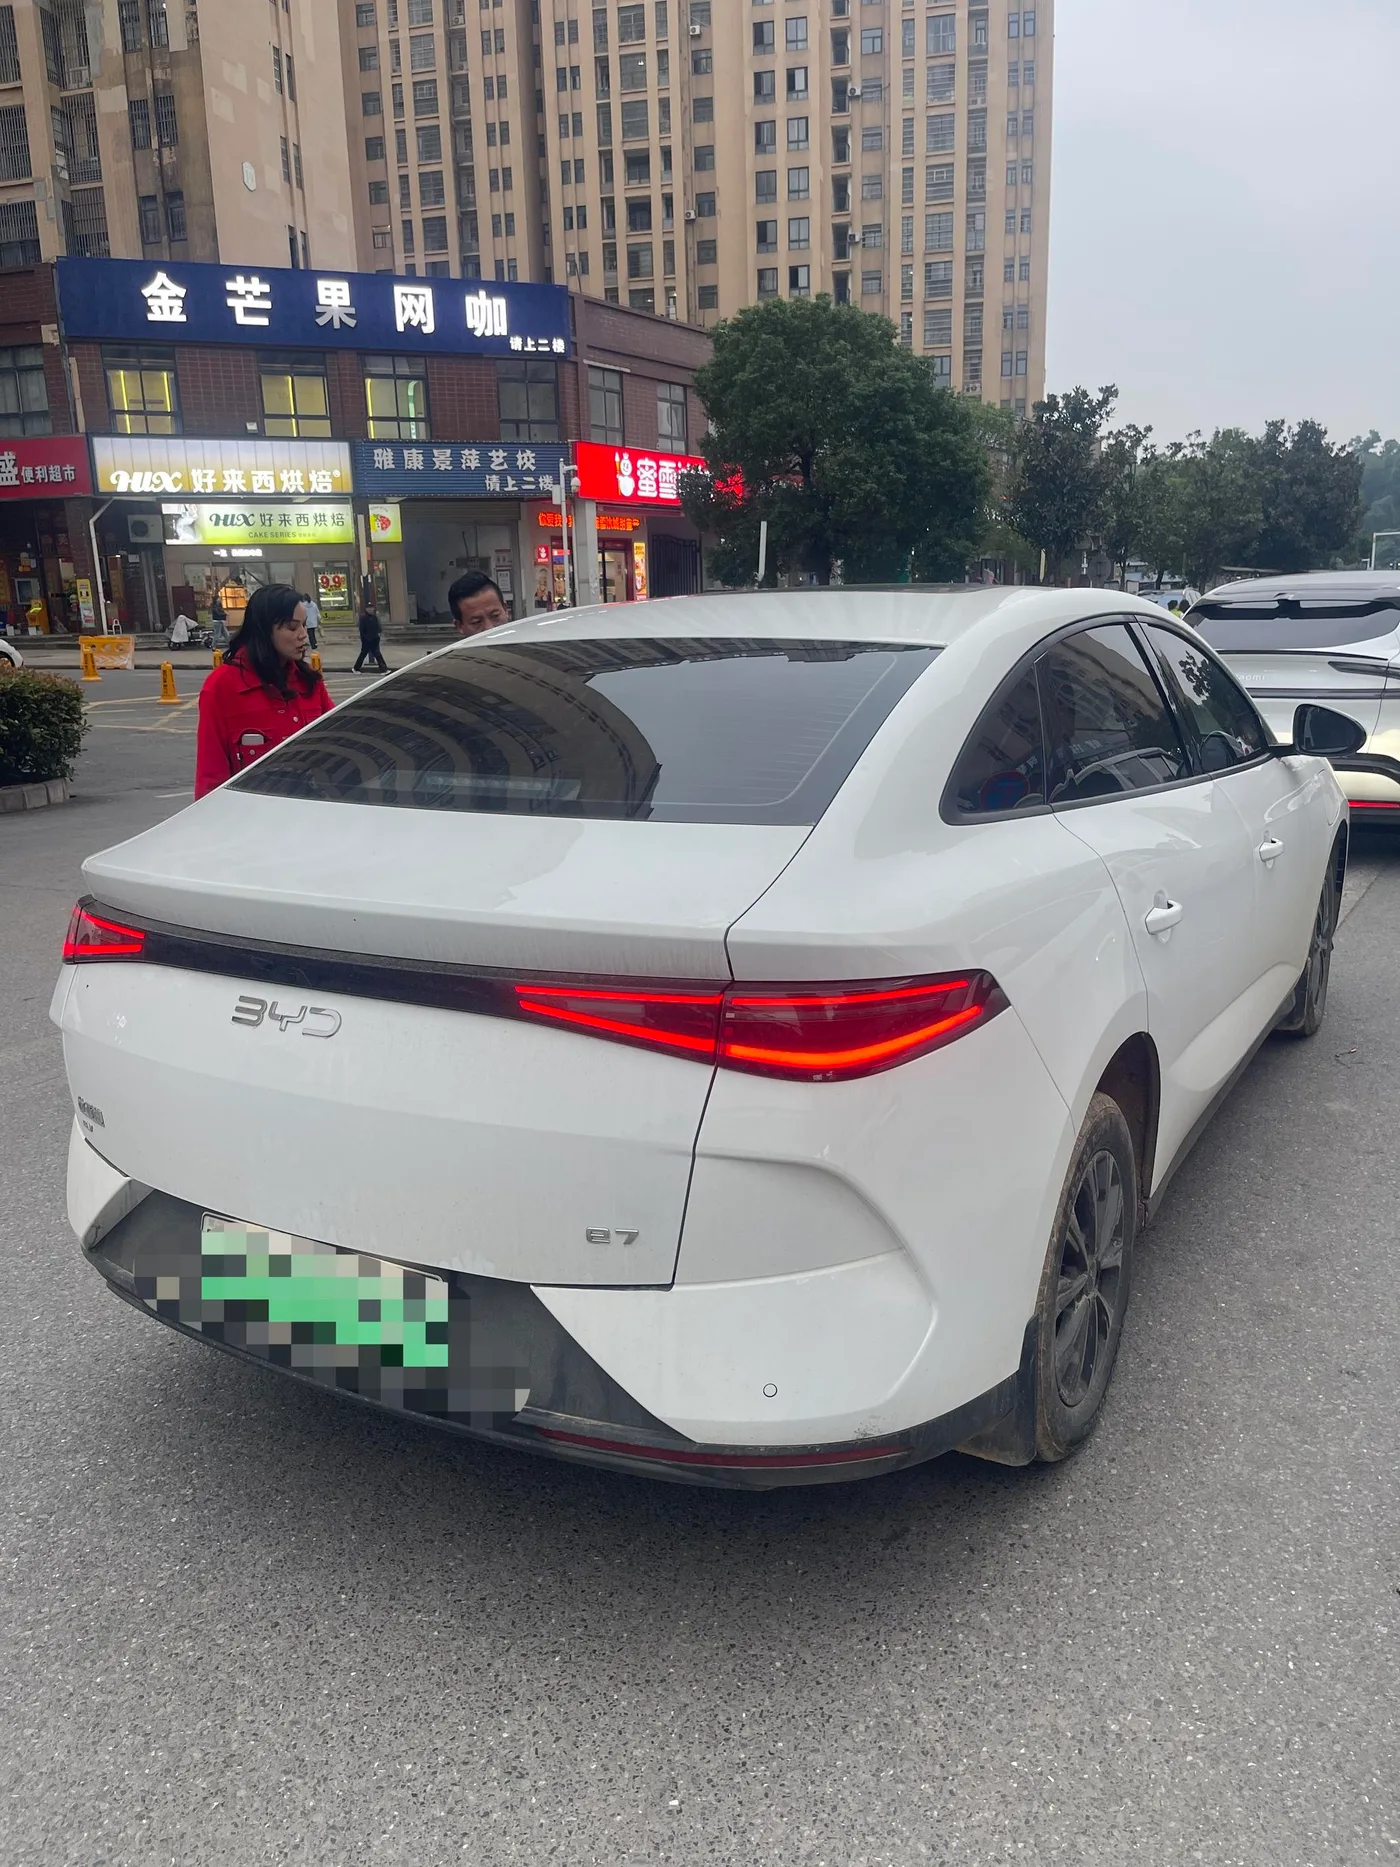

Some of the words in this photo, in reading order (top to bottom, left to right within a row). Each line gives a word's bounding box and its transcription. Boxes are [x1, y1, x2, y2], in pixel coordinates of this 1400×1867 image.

[141, 271, 508, 338] 金芒果网咖
[509, 335, 565, 354] 请上二楼
[22, 464, 76, 483] 便利超市
[191, 468, 334, 494] 好来西烘焙
[485, 474, 554, 492] 请上二楼
[636, 457, 693, 499] 蜜雪
[249, 531, 268, 539] CAKE
[270, 531, 297, 539] SERIES
[231, 995, 342, 1038] BYD
